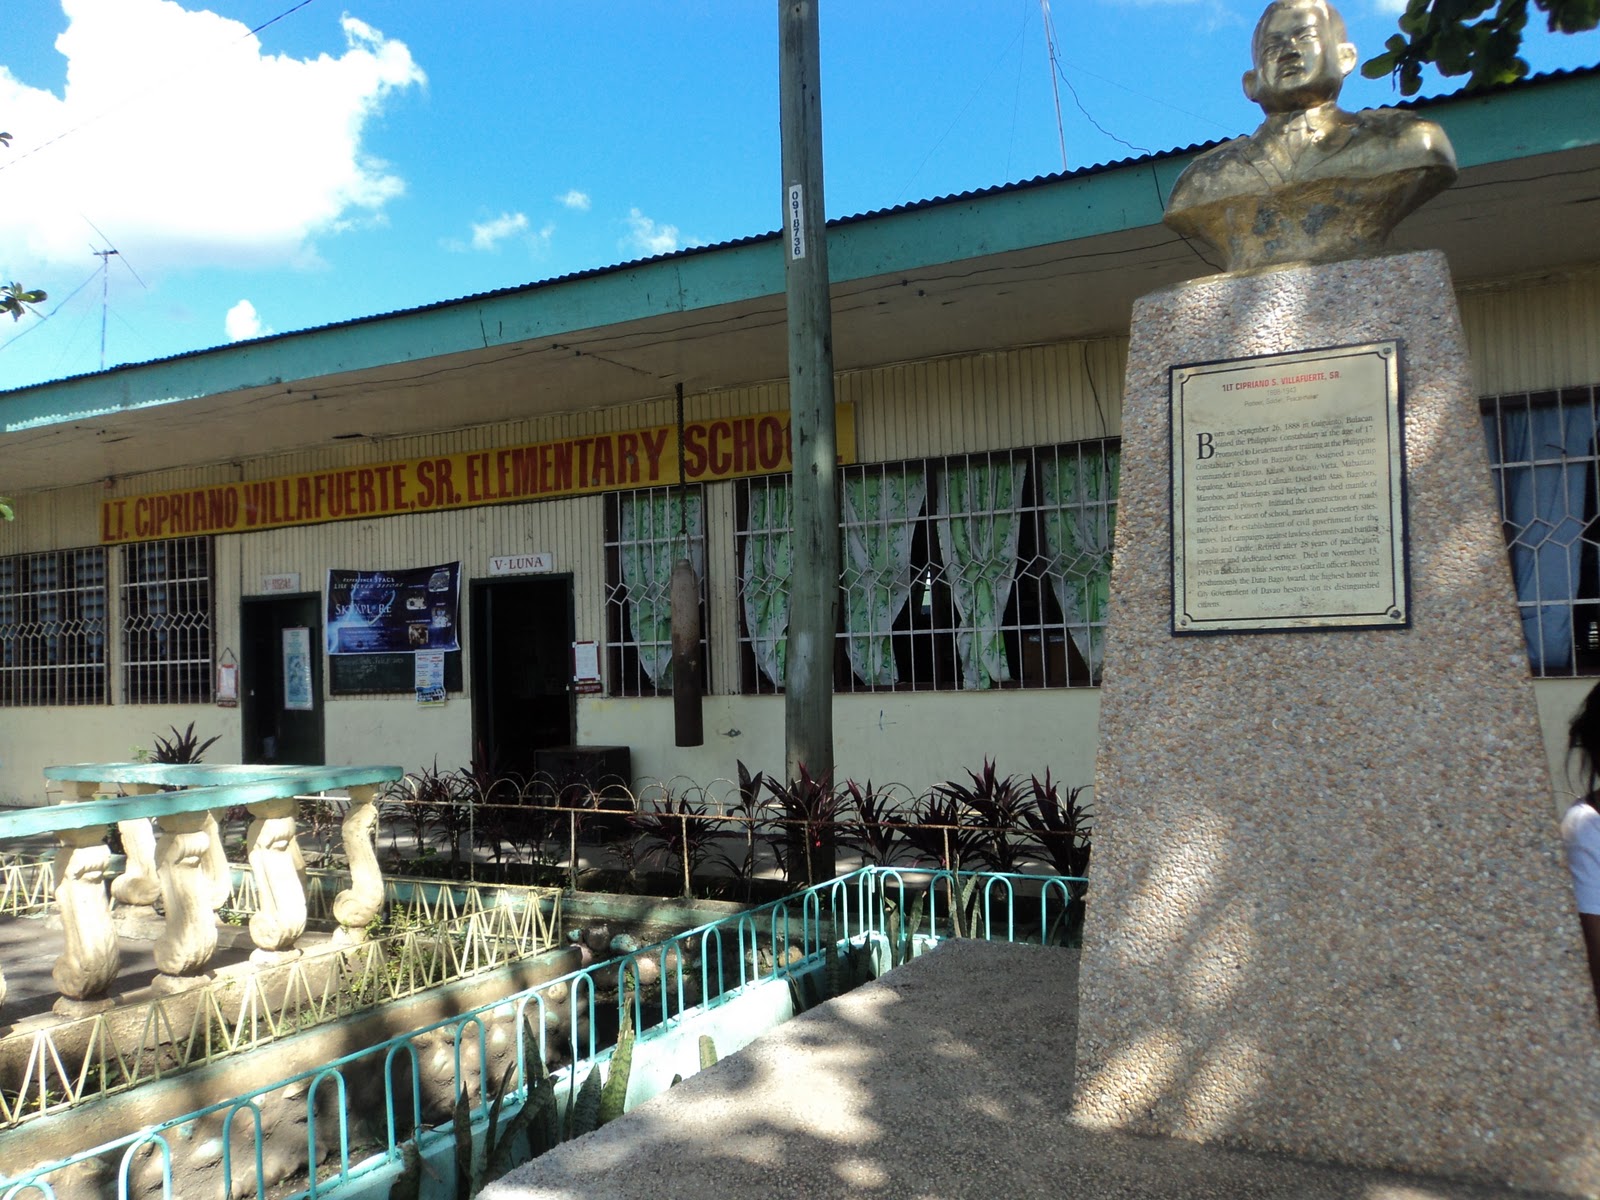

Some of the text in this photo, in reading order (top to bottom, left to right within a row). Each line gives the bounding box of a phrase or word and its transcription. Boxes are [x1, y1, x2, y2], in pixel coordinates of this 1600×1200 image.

[792, 191, 800, 255] 0918736
[1222, 371, 1341, 392] 1LT CIPRIANO S. VILLAFUERTE, SR.
[1237, 425, 1269, 436] September
[1247, 435, 1277, 446] Philippine
[1280, 431, 1319, 443] Constabulary
[1215, 449, 1244, 458] Promoted
[1252, 446, 1283, 455] Lieutenant
[1299, 442, 1323, 452] training
[1342, 437, 1376, 448] Philippine
[1196, 461, 1234, 472] Constabulary
[1237, 458, 1259, 466] School
[1315, 450, 1344, 461] Assigned
[1357, 449, 1376, 457] camp
[103, 413, 842, 541] LT. CIPRIANO VILLAFUERTE, SR. ELEMENTARY SCHO
[1196, 471, 1232, 481] commander
[1286, 486, 1308, 496] helped
[1345, 481, 1368, 490] mantle
[1308, 495, 1348, 504] construction
[1234, 512, 1258, 520] location
[1292, 508, 1314, 516] market
[1330, 505, 1359, 515] cemetery
[1242, 521, 1285, 530] establishment
[1312, 516, 1352, 527] government
[1266, 532, 1288, 541] against
[1311, 528, 1340, 536] elements
[494, 556, 544, 570] V-LUNA
[1242, 554, 1272, 563] dedicated
[1332, 549, 1366, 557] November
[1269, 565, 1291, 574] serving
[1350, 559, 1380, 567] Received
[1268, 576, 1284, 585] Bago
[1321, 572, 1345, 582] highest
[1211, 589, 1249, 597] Government
[1334, 582, 1380, 592] distinguished
